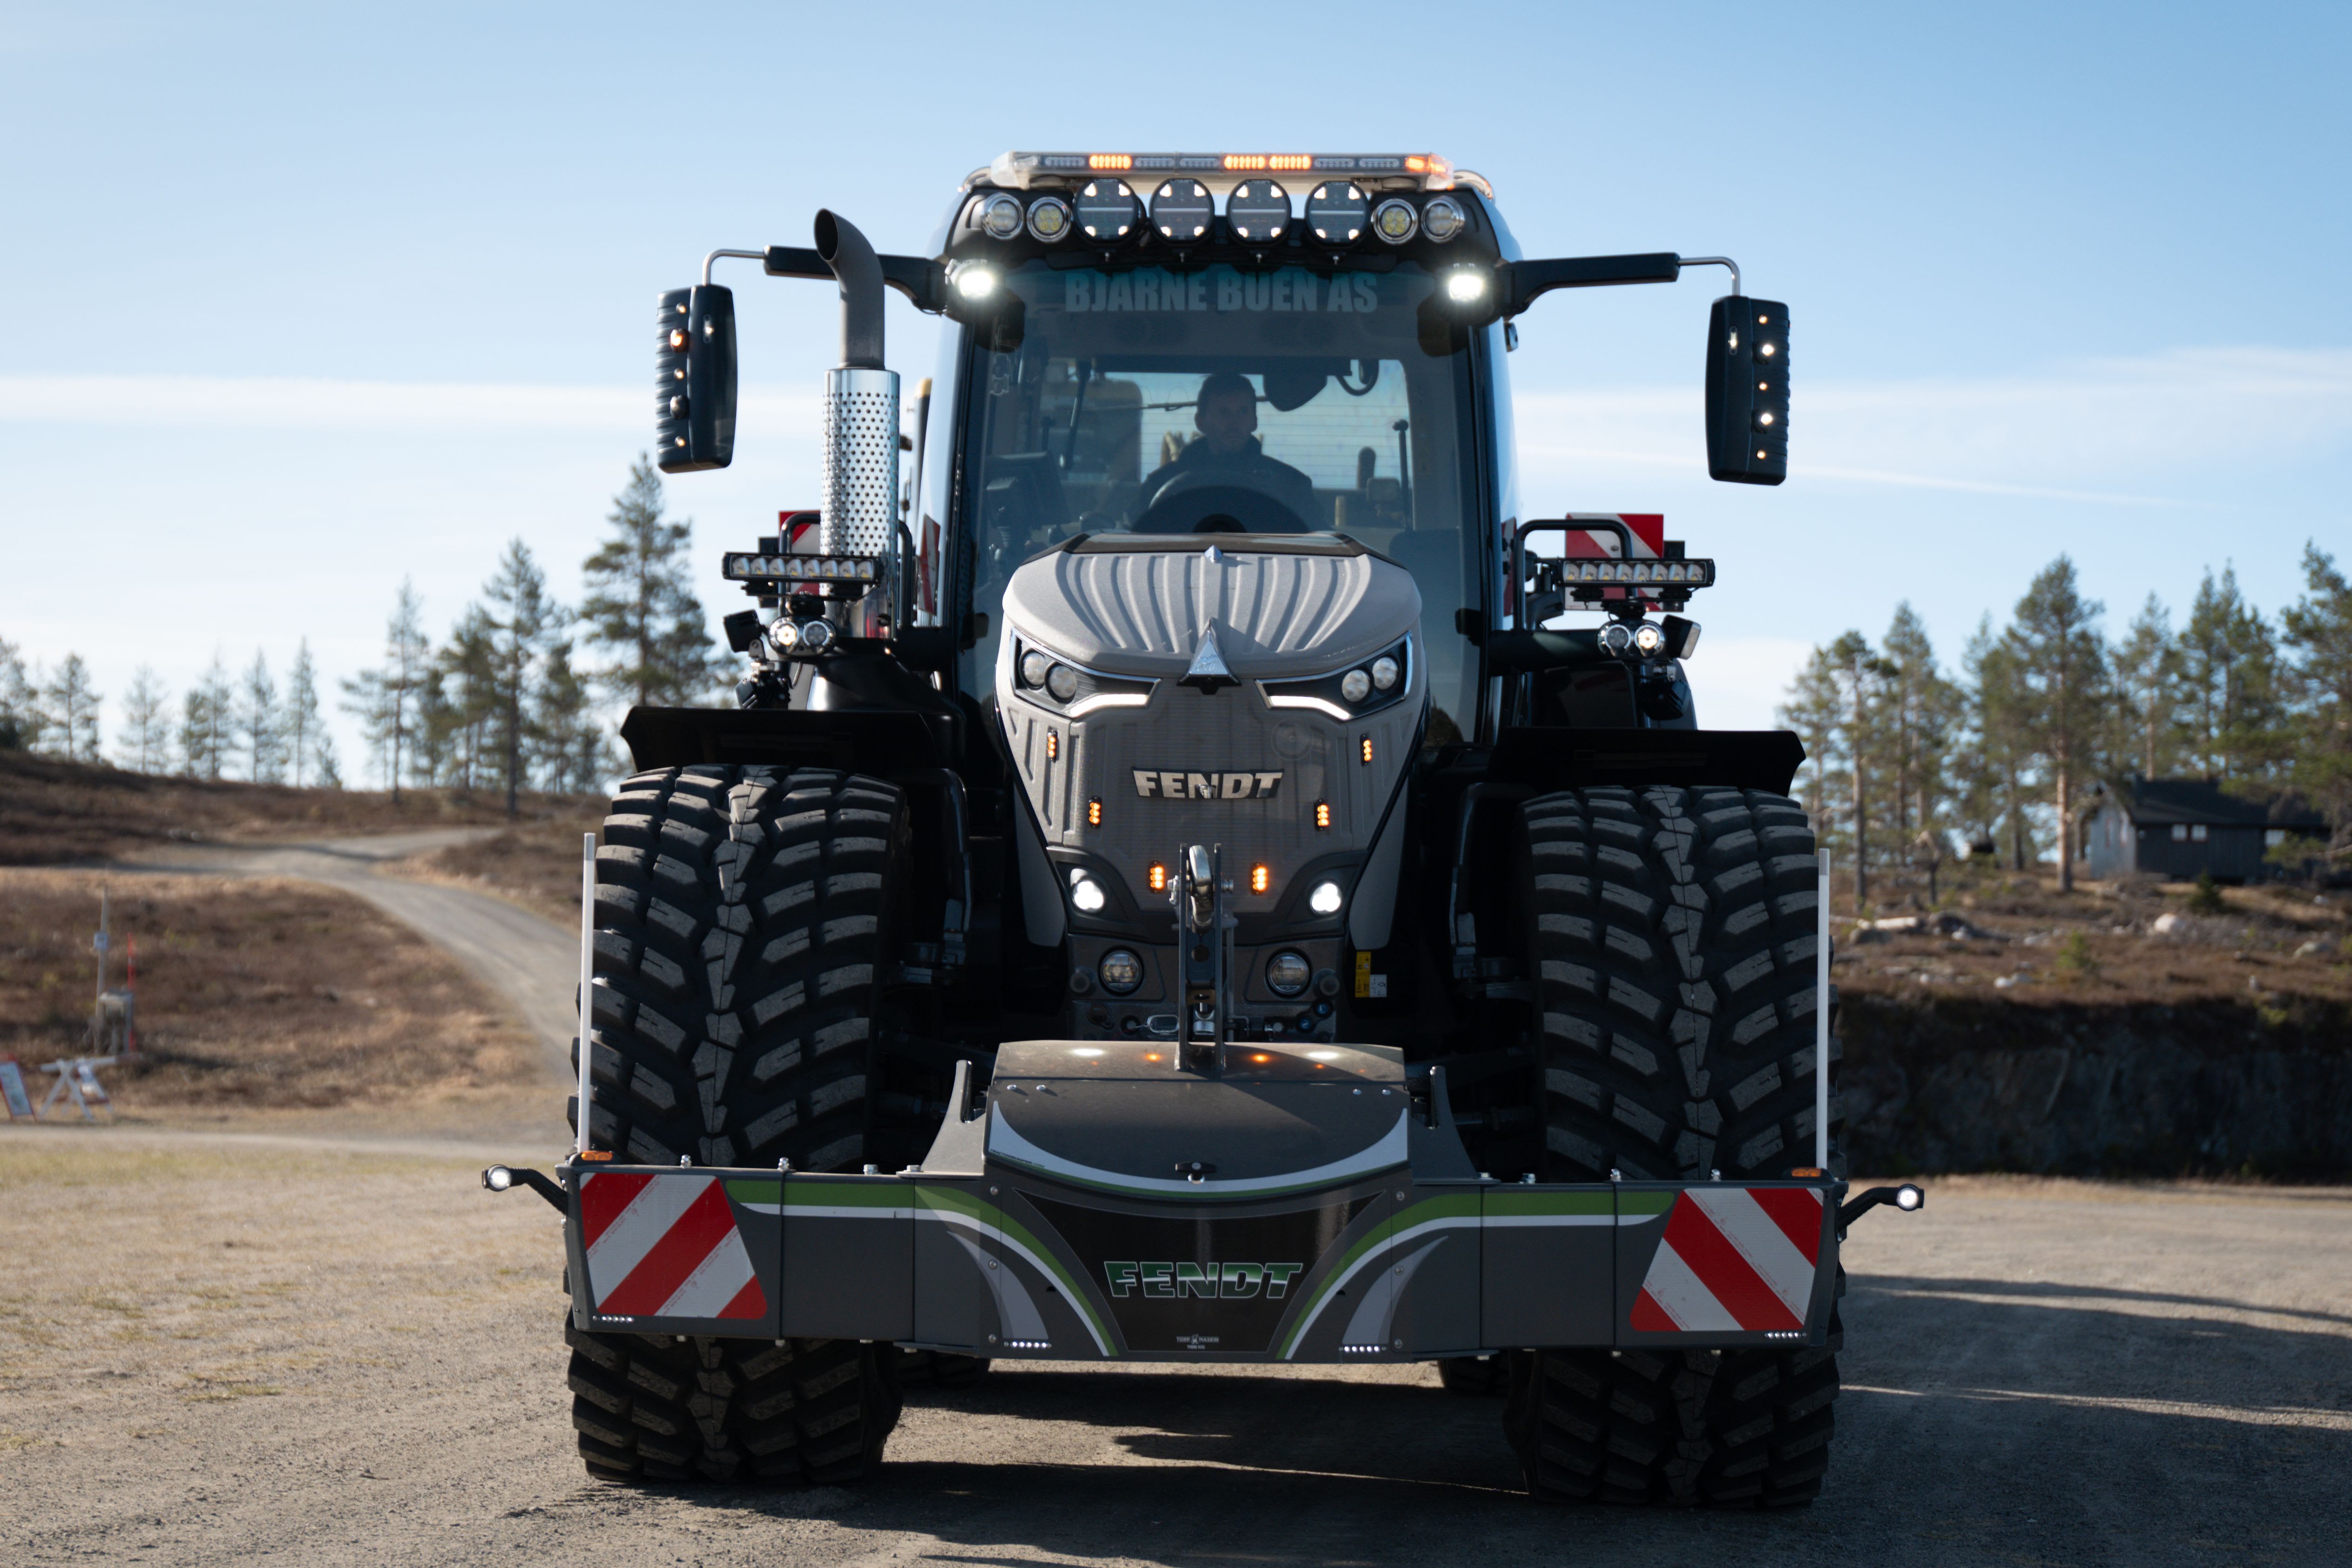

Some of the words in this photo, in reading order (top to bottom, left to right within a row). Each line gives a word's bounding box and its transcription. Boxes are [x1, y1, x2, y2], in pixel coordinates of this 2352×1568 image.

[1065, 273, 1207, 312] BJARNE
[1217, 273, 1317, 312] BUEN
[1326, 273, 1378, 313] AS
[1133, 770, 1283, 799] FENDT
[1104, 1261, 1303, 1298] FENDT
